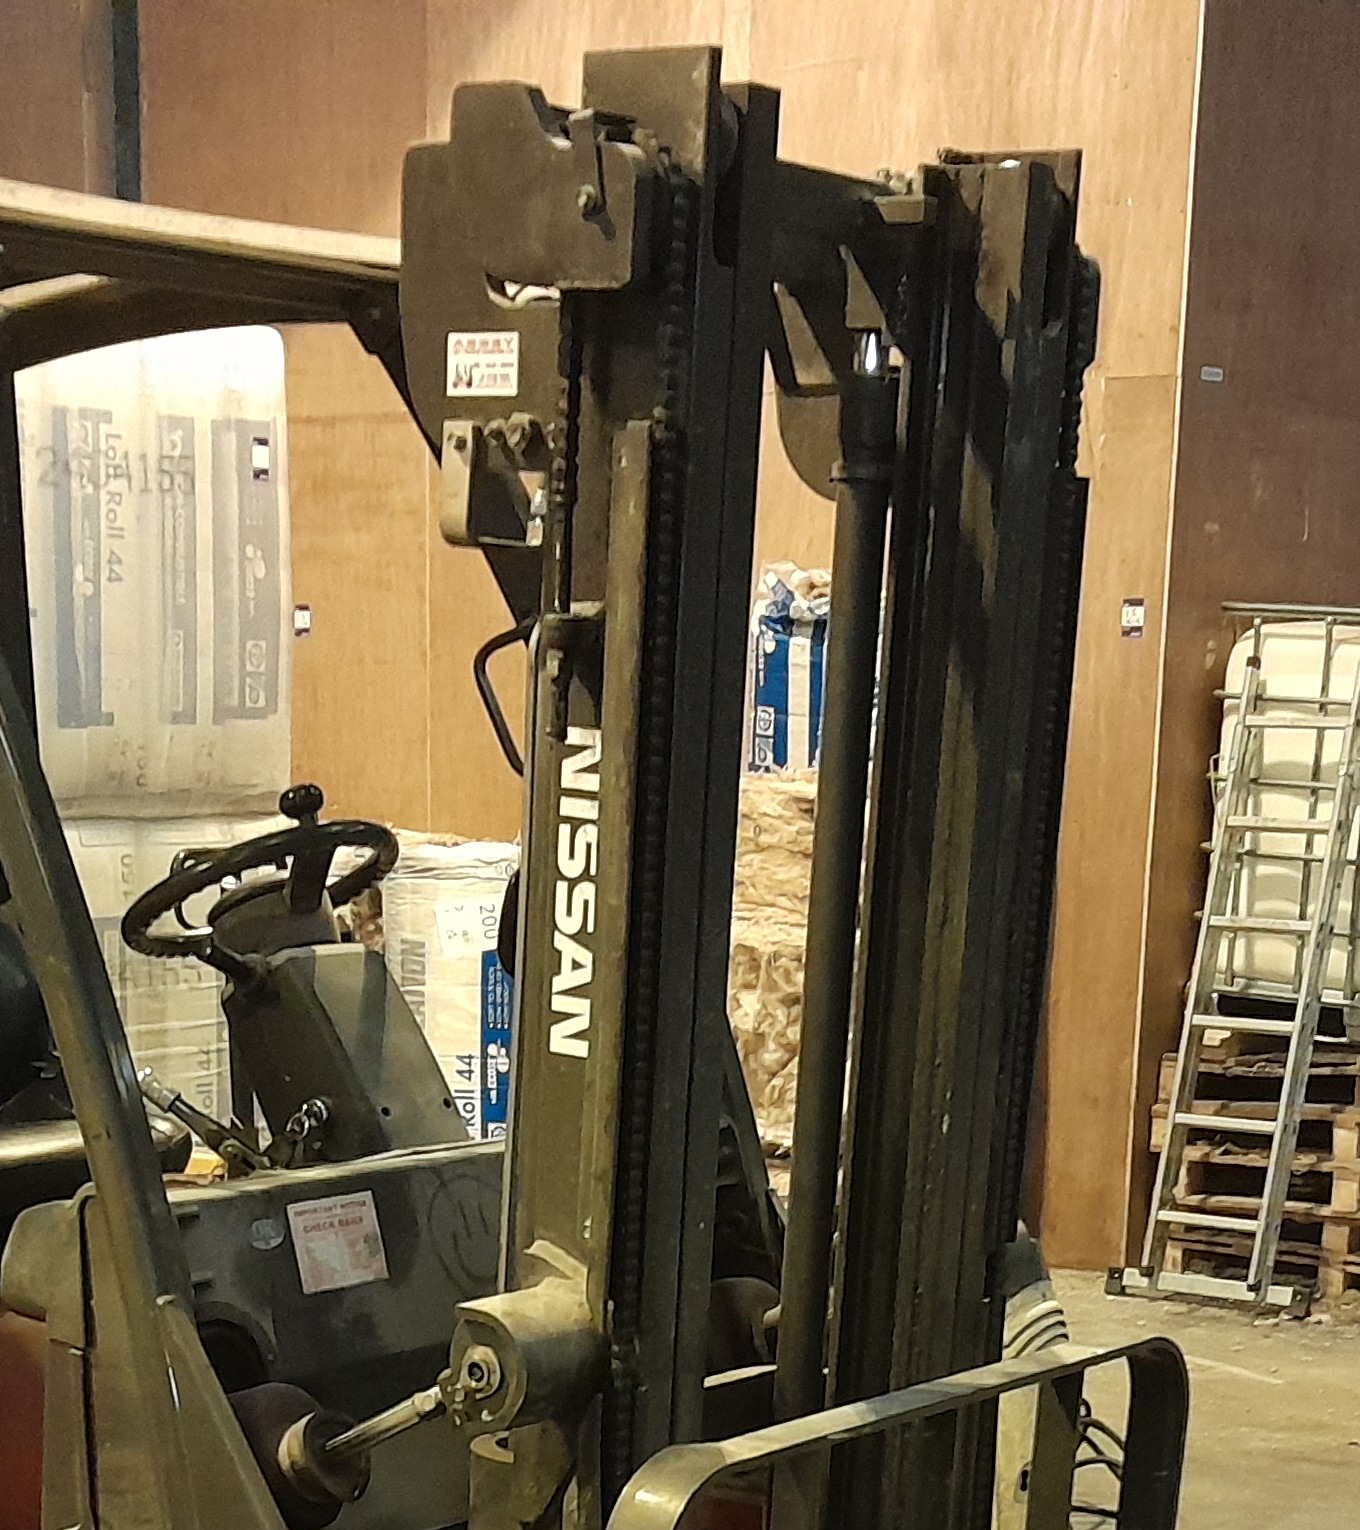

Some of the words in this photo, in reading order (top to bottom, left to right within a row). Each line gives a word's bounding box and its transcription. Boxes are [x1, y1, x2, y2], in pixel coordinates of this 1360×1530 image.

[105, 490, 126, 541] Roll
[107, 548, 124, 585] 44
[549, 725, 602, 1059] NISSAN
[456, 1053, 474, 1082] 44
